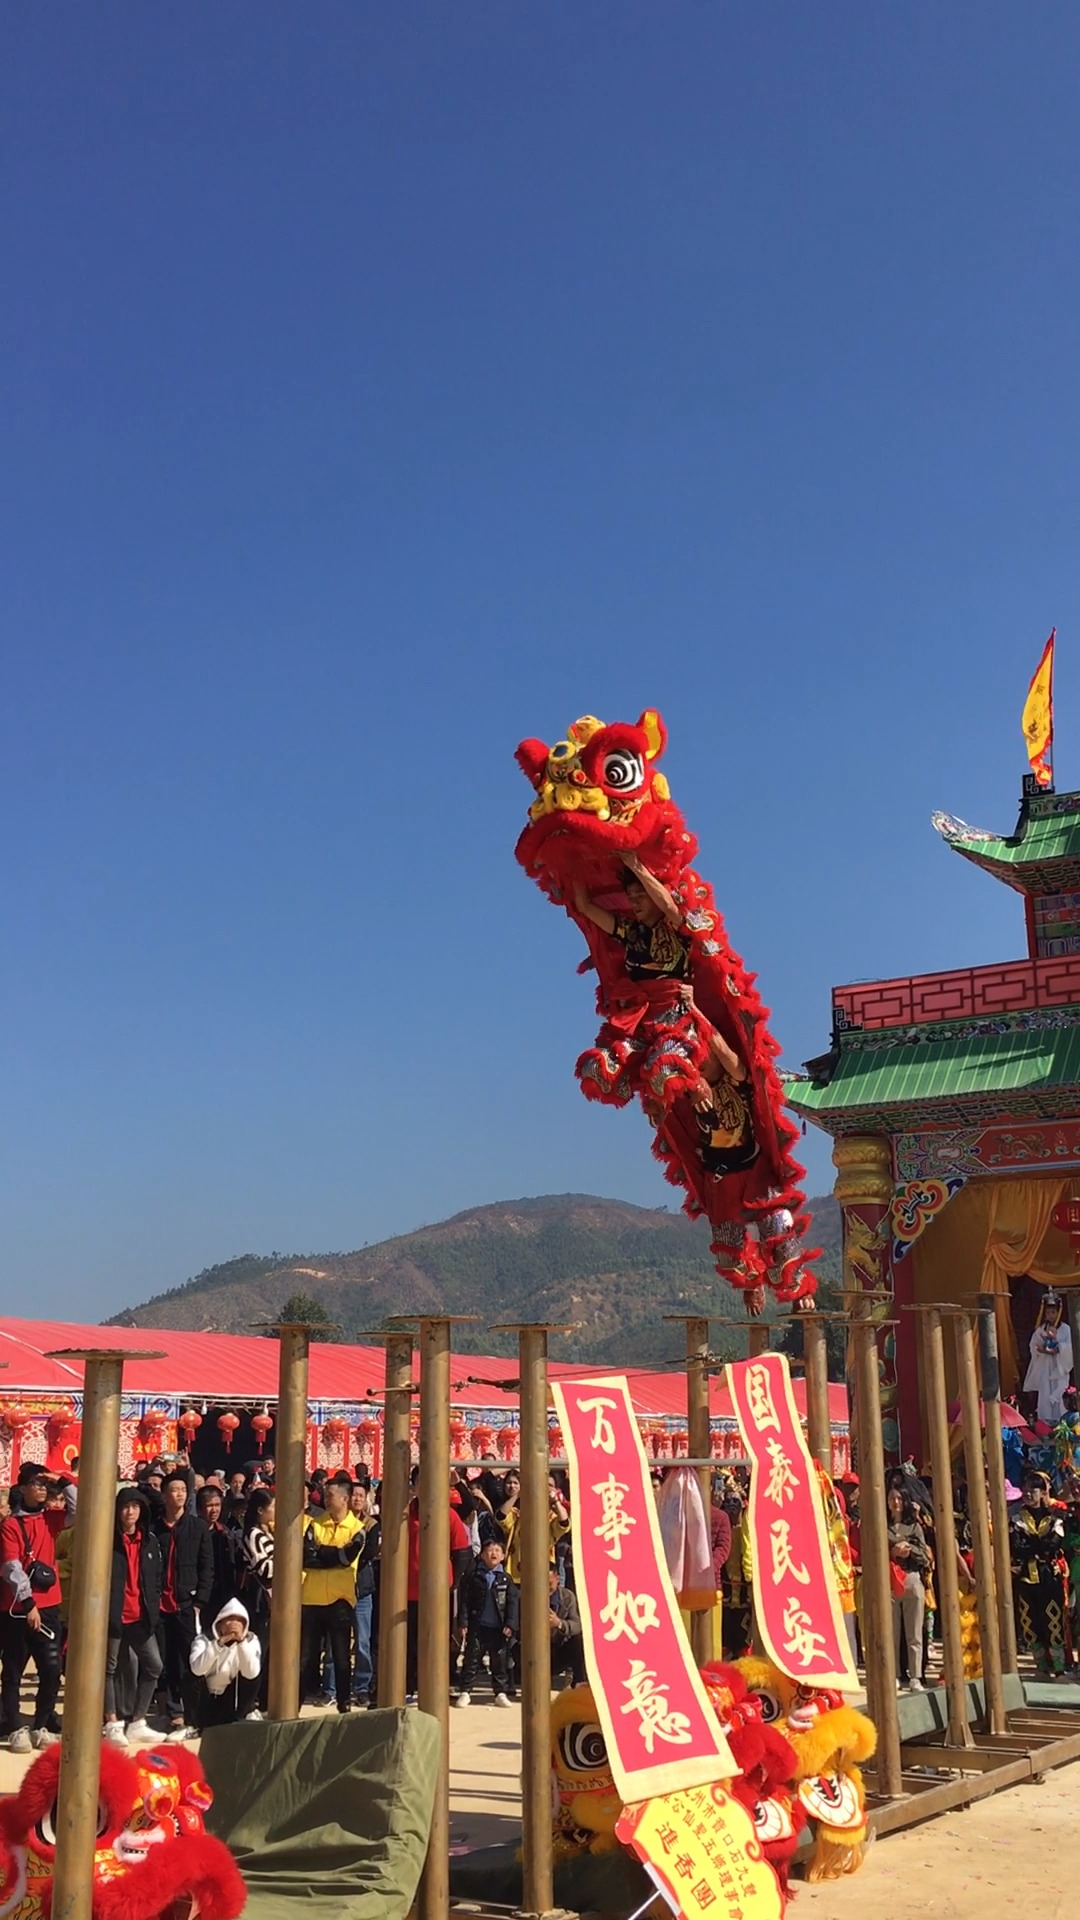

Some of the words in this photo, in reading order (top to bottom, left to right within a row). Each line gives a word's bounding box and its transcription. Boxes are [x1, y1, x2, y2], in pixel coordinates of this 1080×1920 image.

[576, 1396, 693, 1754] 万事如意
[745, 1364, 835, 1669] 国泰民安
[655, 1821, 717, 1911] 進香團
